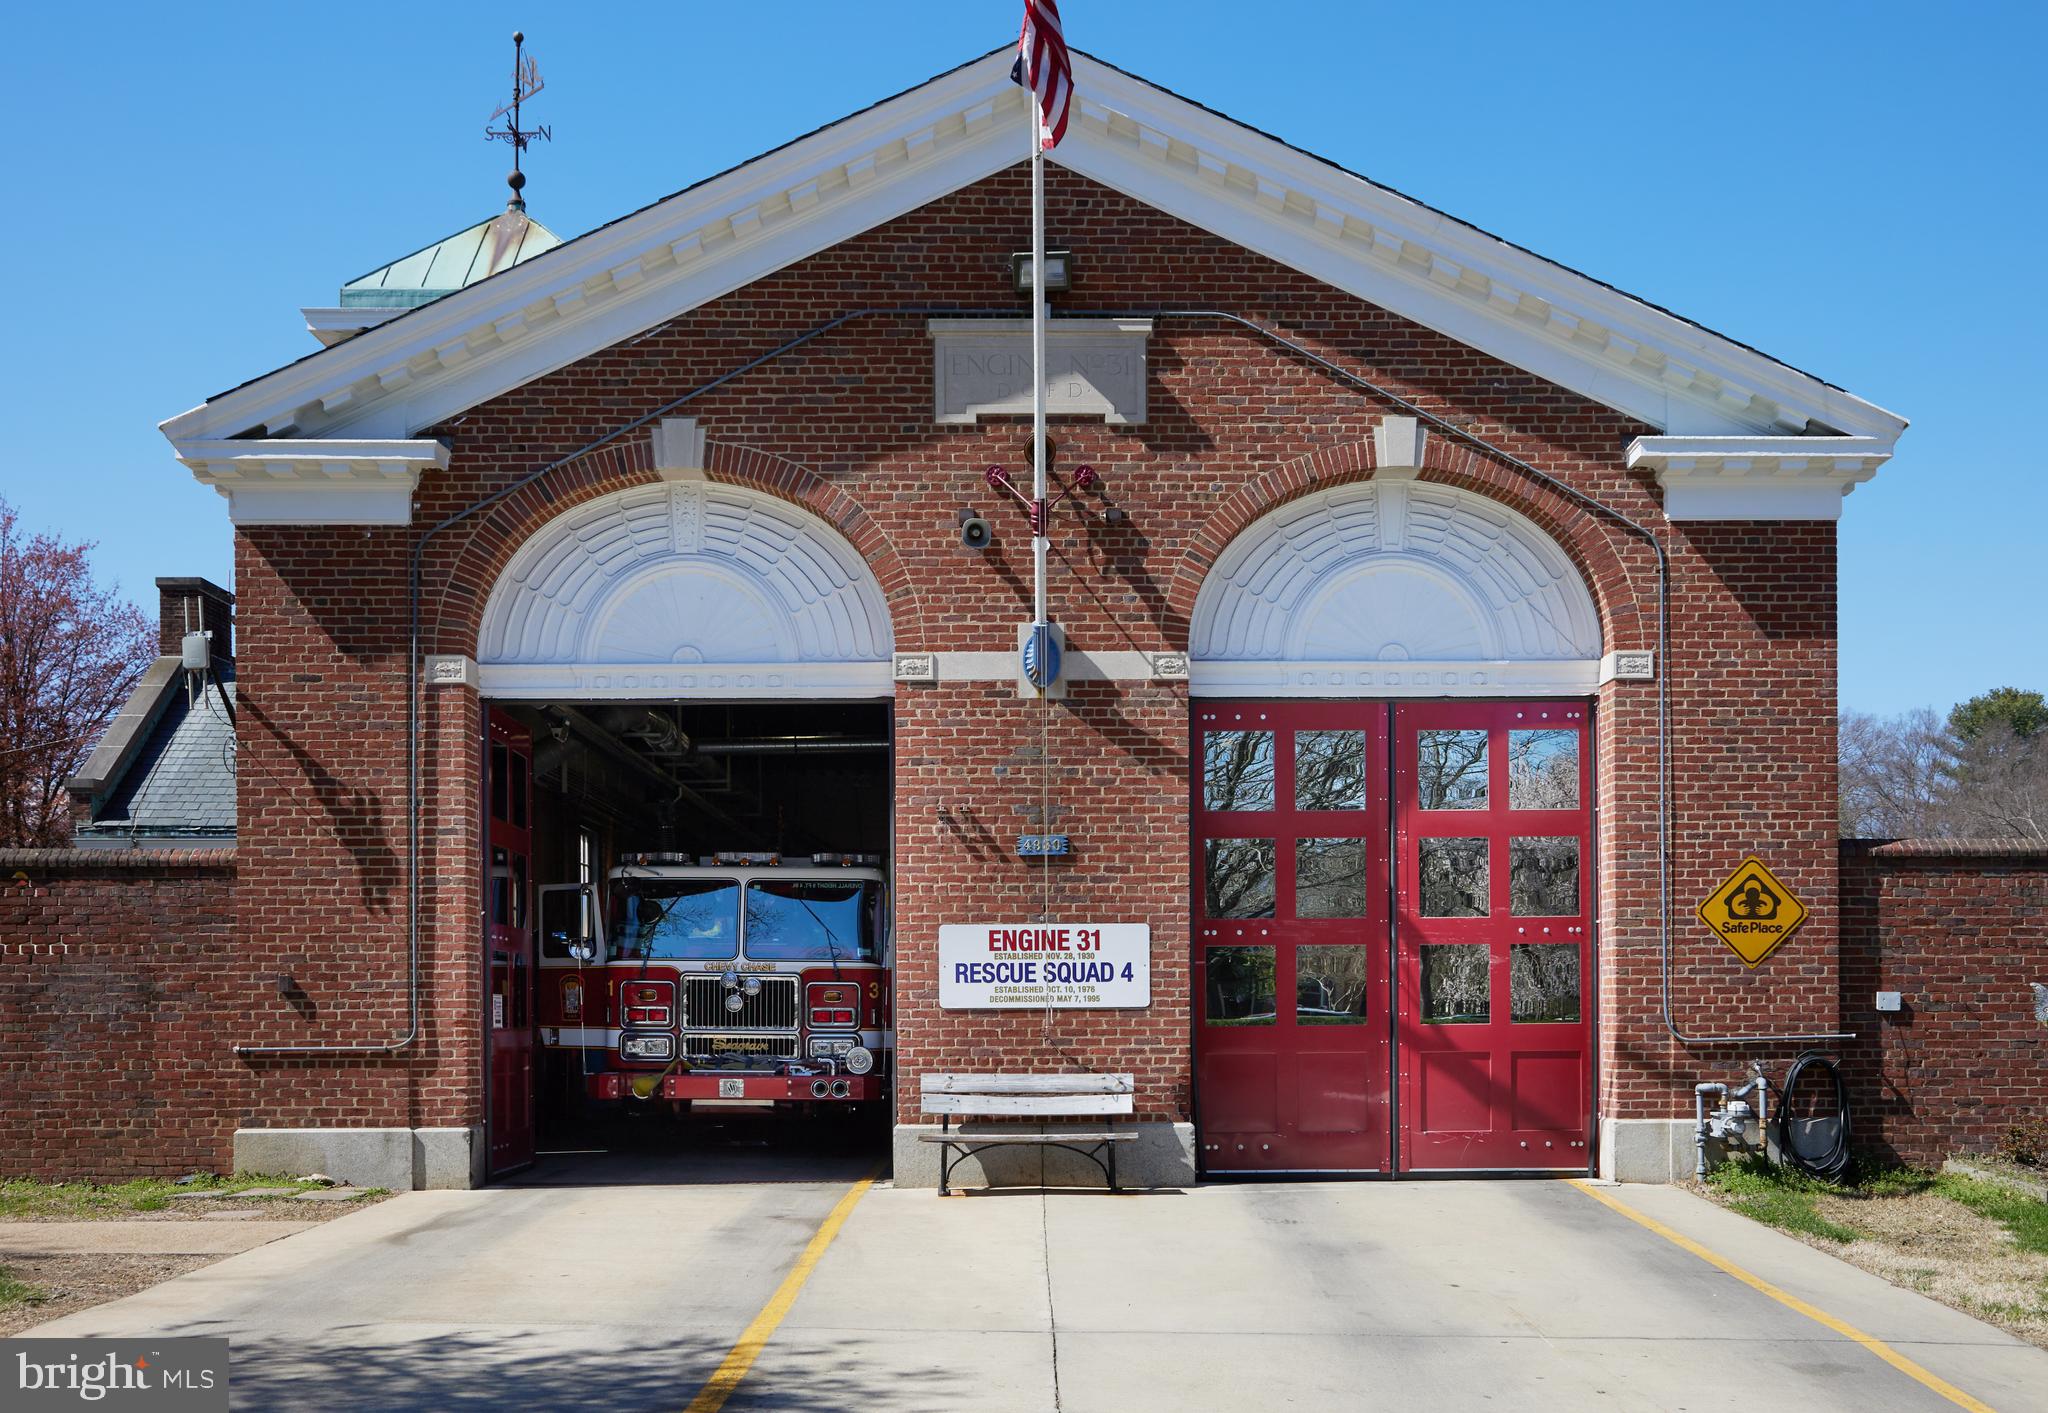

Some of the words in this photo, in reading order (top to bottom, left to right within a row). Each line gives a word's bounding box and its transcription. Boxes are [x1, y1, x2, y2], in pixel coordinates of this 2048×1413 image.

[485, 126, 495, 141] S
[539, 125, 551, 142] N
[989, 929, 1070, 951] ENGINE
[1077, 929, 1101, 951] 31
[994, 952, 1043, 960] ESTABLISHED
[1045, 952, 1062, 960] NOV.
[1064, 952, 1075, 961] 28,
[1077, 952, 1095, 960] 1930
[704, 961, 738, 972] CHEVY
[741, 962, 777, 972] CHASE
[955, 962, 1037, 984] RESCUE
[1043, 962, 1114, 984] SQUAD
[1120, 962, 1134, 983] 4
[994, 986, 1043, 994] ESTABLISHED
[1064, 986, 1076, 994] 10,
[989, 995, 1055, 1003] DECOMMISSIONED
[1056, 995, 1073, 1003] MAY
[1083, 995, 1101, 1003] 1995
